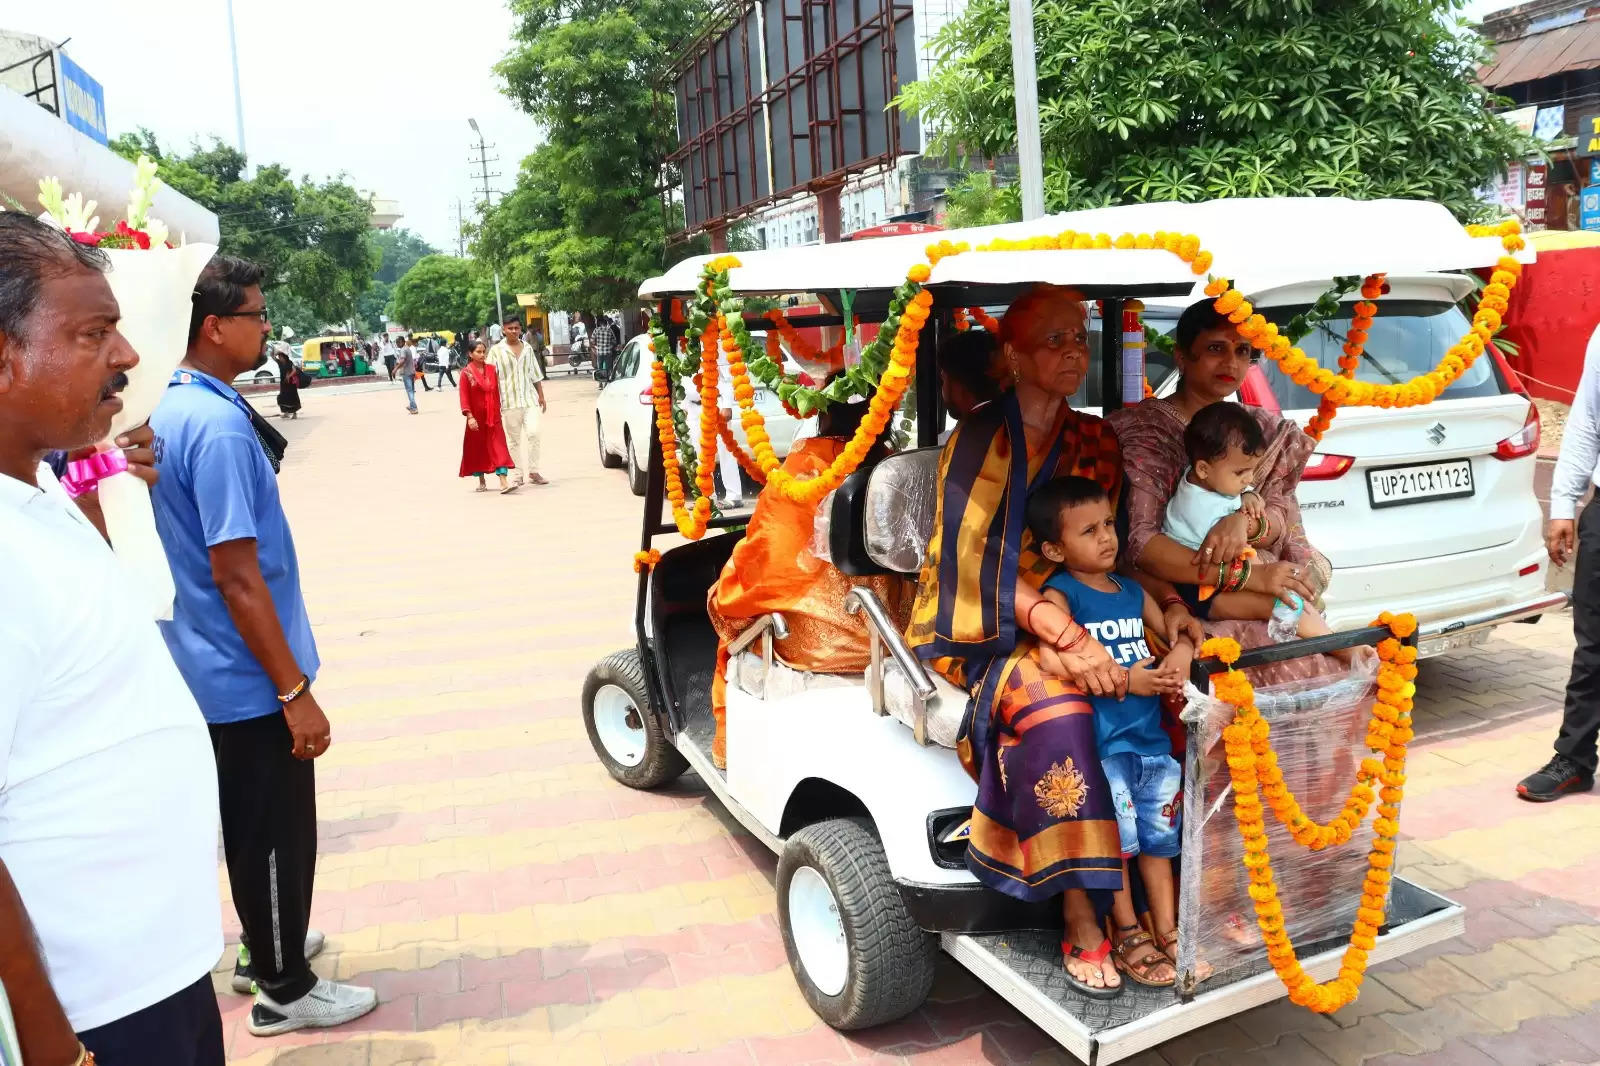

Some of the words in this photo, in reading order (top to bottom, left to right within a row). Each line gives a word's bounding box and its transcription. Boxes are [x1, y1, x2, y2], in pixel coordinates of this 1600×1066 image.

[1527, 208, 1545, 220] GUEST
[1381, 467, 1470, 496] UP21CX1123
[1299, 499, 1345, 511] ERTIGA
